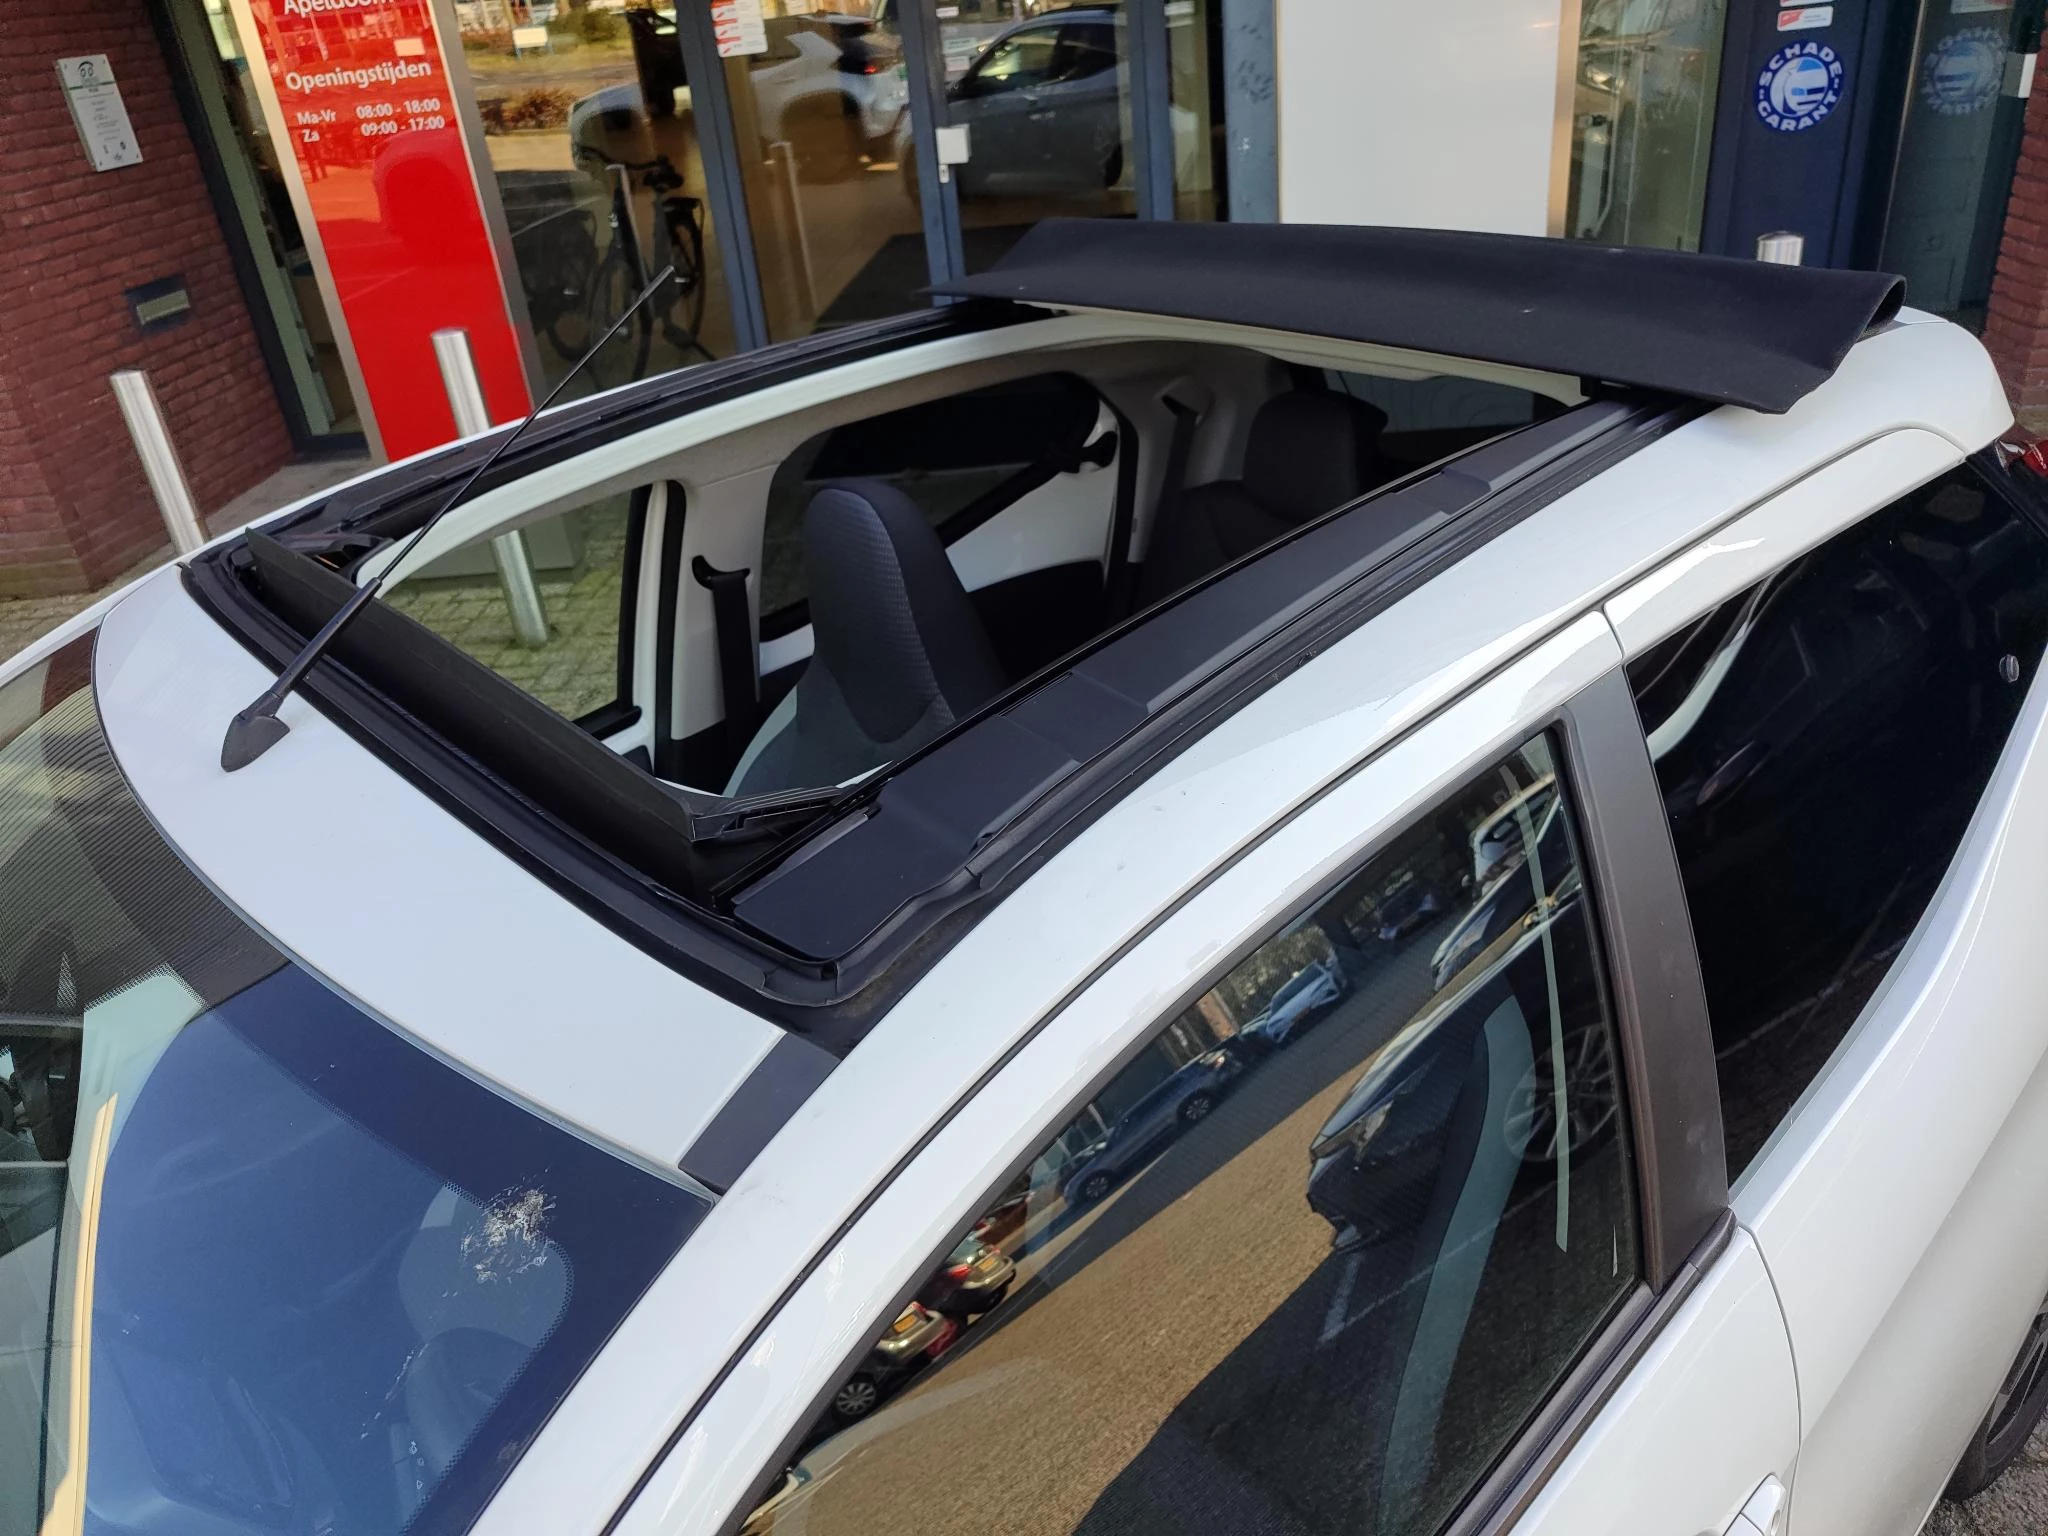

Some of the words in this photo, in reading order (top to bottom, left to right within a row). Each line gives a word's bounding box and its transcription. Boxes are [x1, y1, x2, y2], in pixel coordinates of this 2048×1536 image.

[284, 0, 395, 18] Apeldo
[286, 61, 431, 93] Openingstijden
[1758, 41, 1843, 87] SCHADE
[297, 109, 336, 125] Ma-Vr
[355, 103, 393, 120] 08:00
[403, 98, 440, 114] 18:00
[303, 129, 320, 142] Za
[361, 120, 398, 137] 09:00
[408, 115, 445, 131] 17:00
